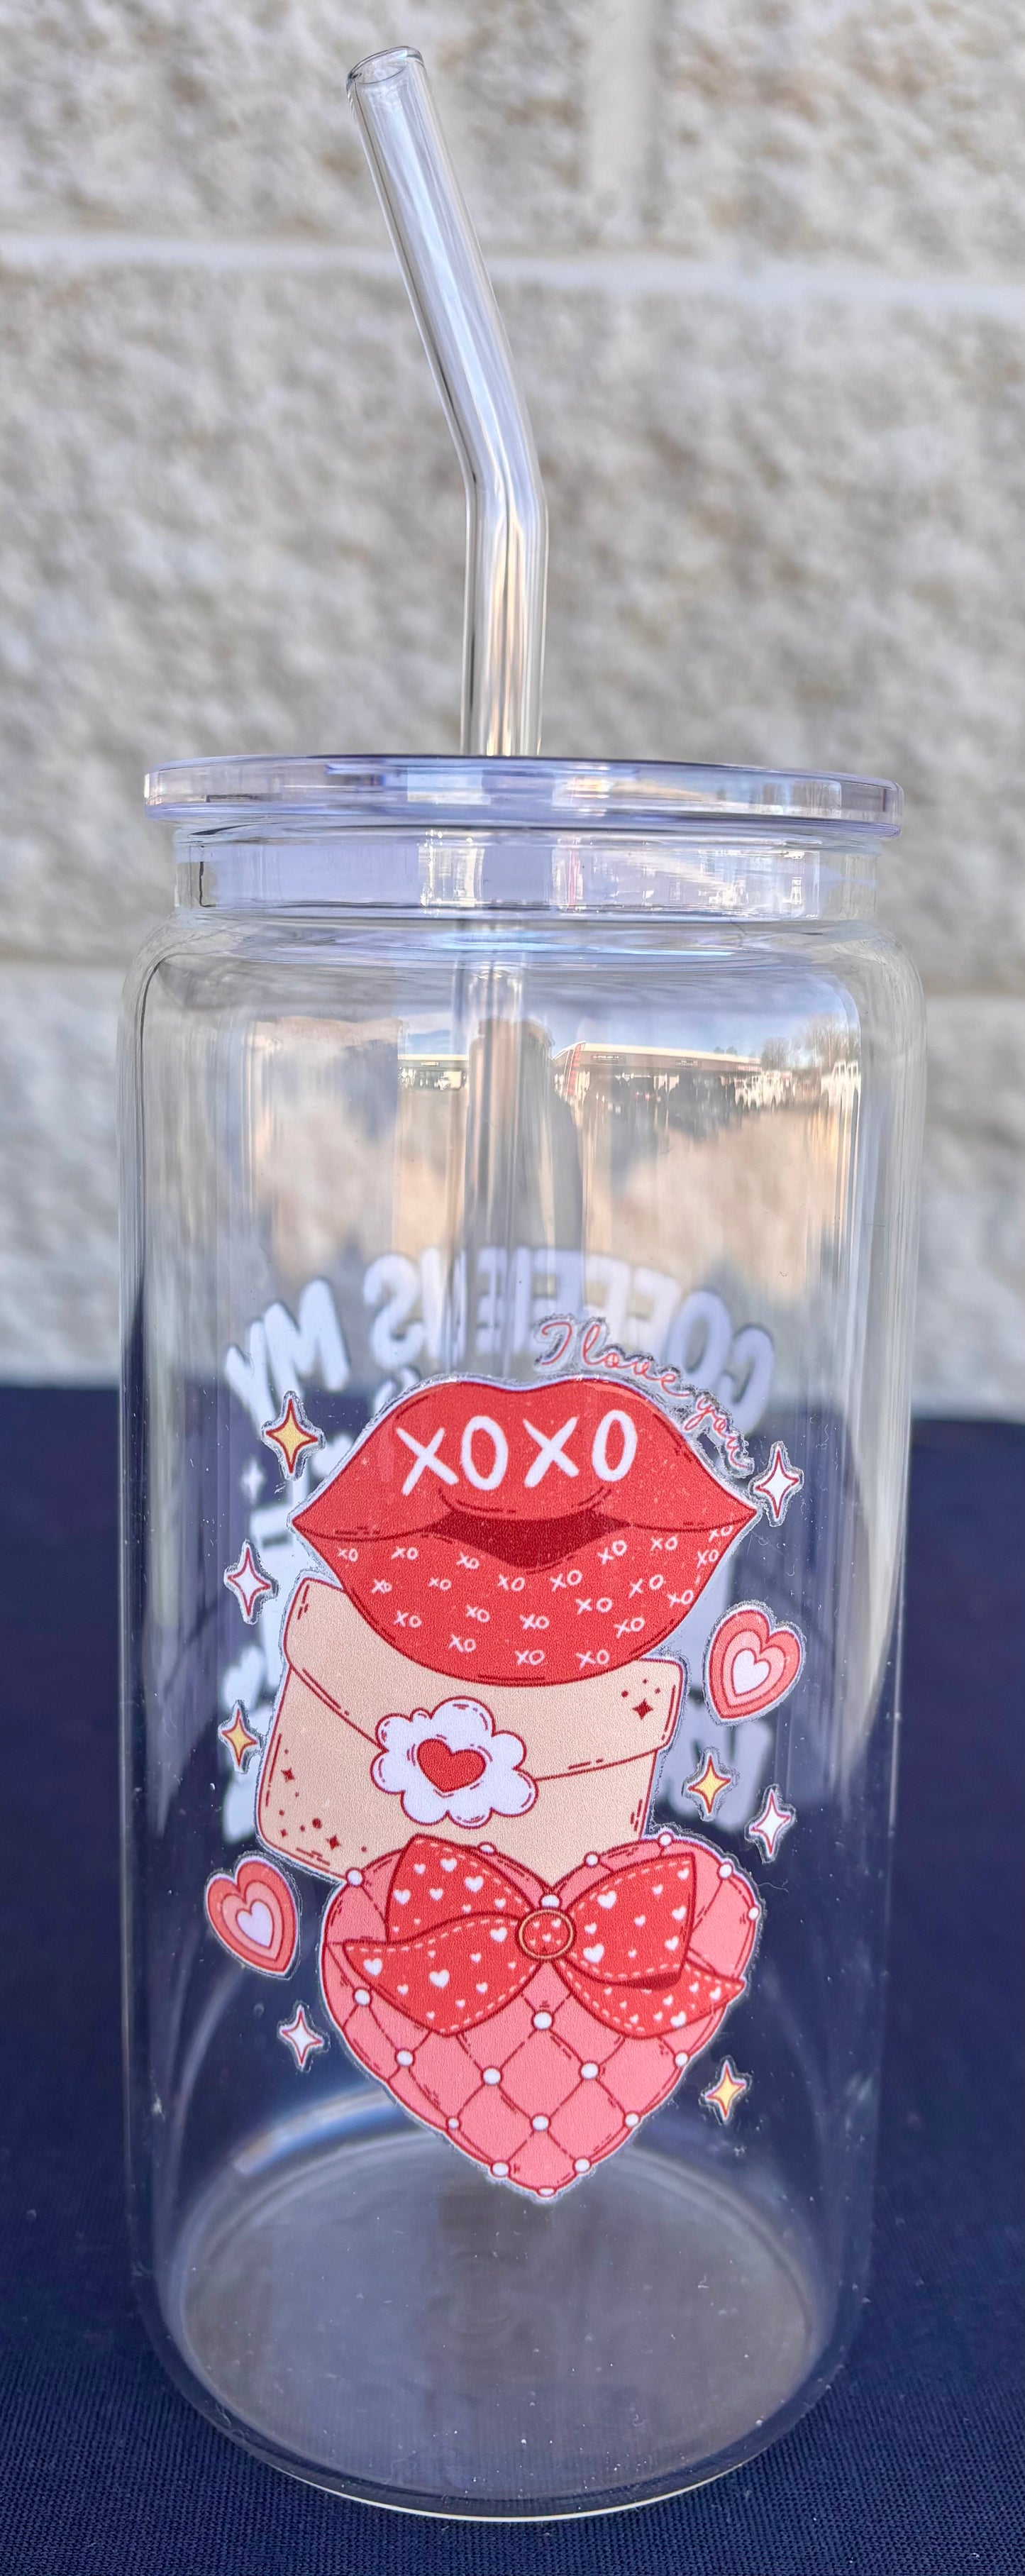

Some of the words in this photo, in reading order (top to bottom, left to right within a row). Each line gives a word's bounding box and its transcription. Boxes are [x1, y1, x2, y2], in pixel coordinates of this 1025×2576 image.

[541, 1322, 572, 1366] I
[582, 1324, 690, 1397] love
[683, 1396, 750, 1469] you
[394, 1409, 638, 1497] XOXO
[597, 1539, 628, 1565] XO
[650, 1535, 678, 1551] XO
[338, 1548, 358, 1562] XO
[391, 1547, 419, 1560] XO
[456, 1552, 480, 1569] XO
[697, 1549, 719, 1569] XO
[372, 1579, 392, 1593] XO
[428, 1578, 451, 1591] XO
[497, 1574, 525, 1591] XO
[550, 1569, 582, 1591] XO
[628, 1574, 664, 1598] XO
[575, 1597, 613, 1615] XO
[667, 1589, 694, 1608] XO
[394, 1610, 422, 1628] XO
[466, 1605, 490, 1623] XO
[519, 1613, 550, 1630] XO
[614, 1616, 646, 1638] XO
[449, 1634, 476, 1652] XO
[515, 1649, 545, 1666] XO
[575, 1649, 610, 1669] XO
